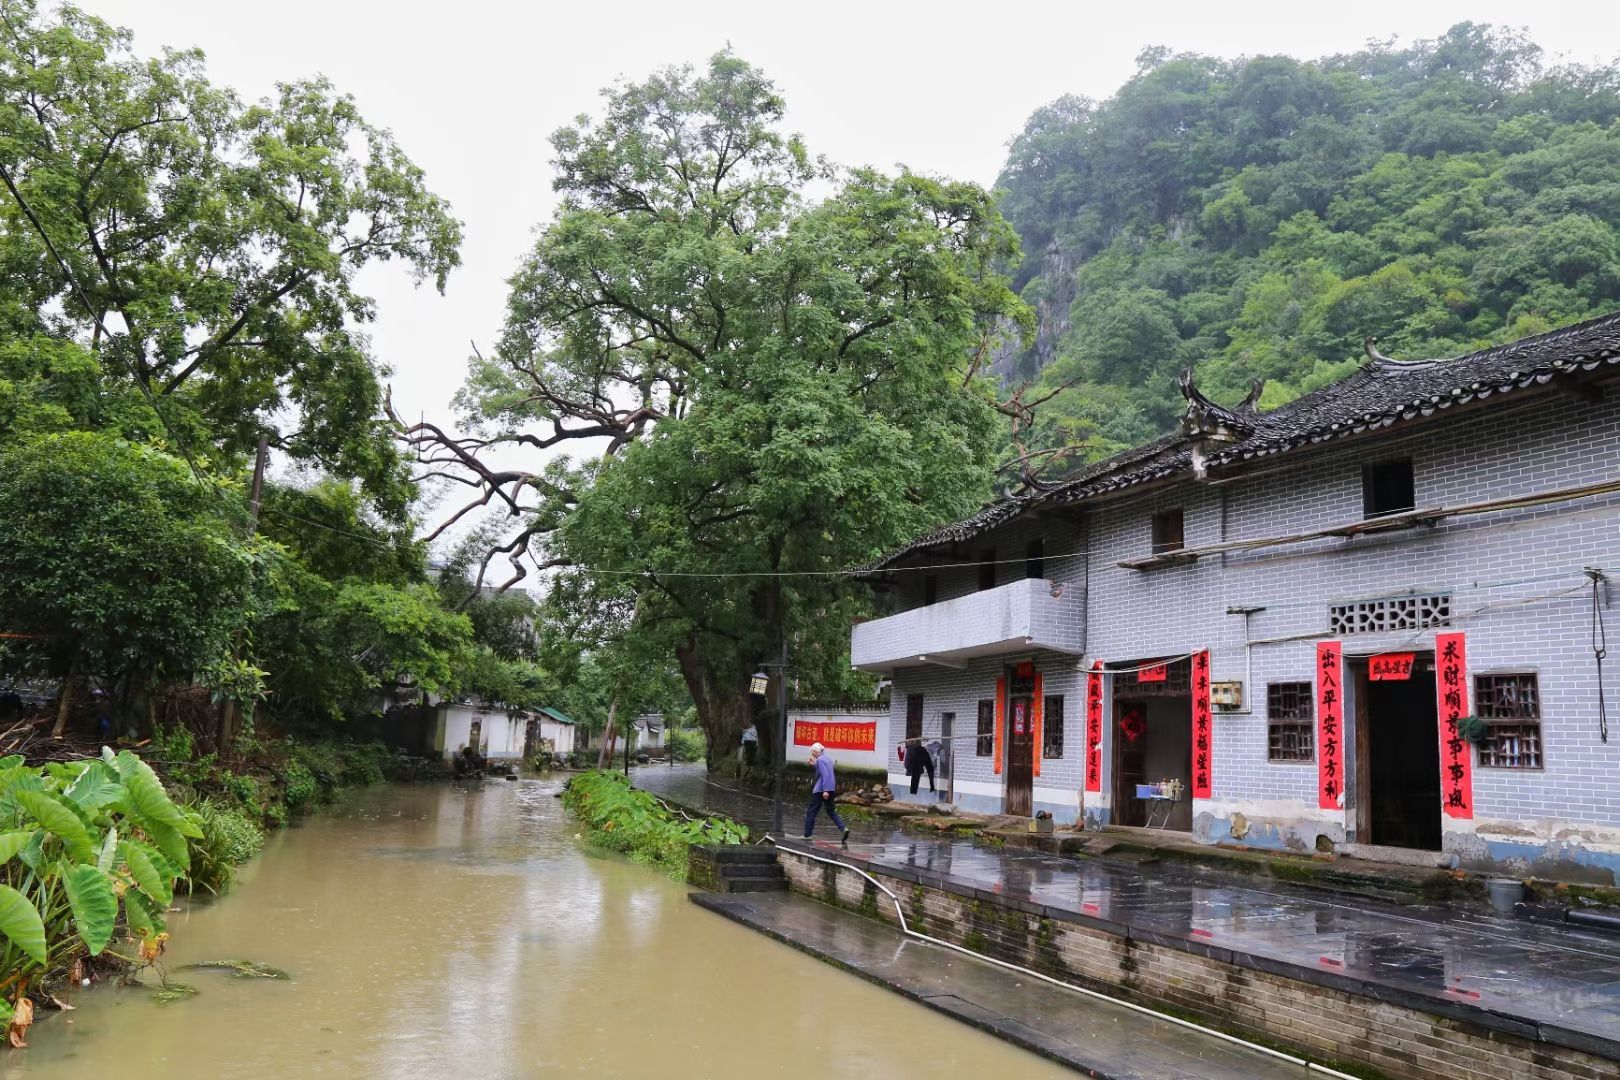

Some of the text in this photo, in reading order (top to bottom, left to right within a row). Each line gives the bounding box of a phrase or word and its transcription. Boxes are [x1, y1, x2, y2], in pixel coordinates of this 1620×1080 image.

[1322, 648, 1338, 801] 出入平安方方利
